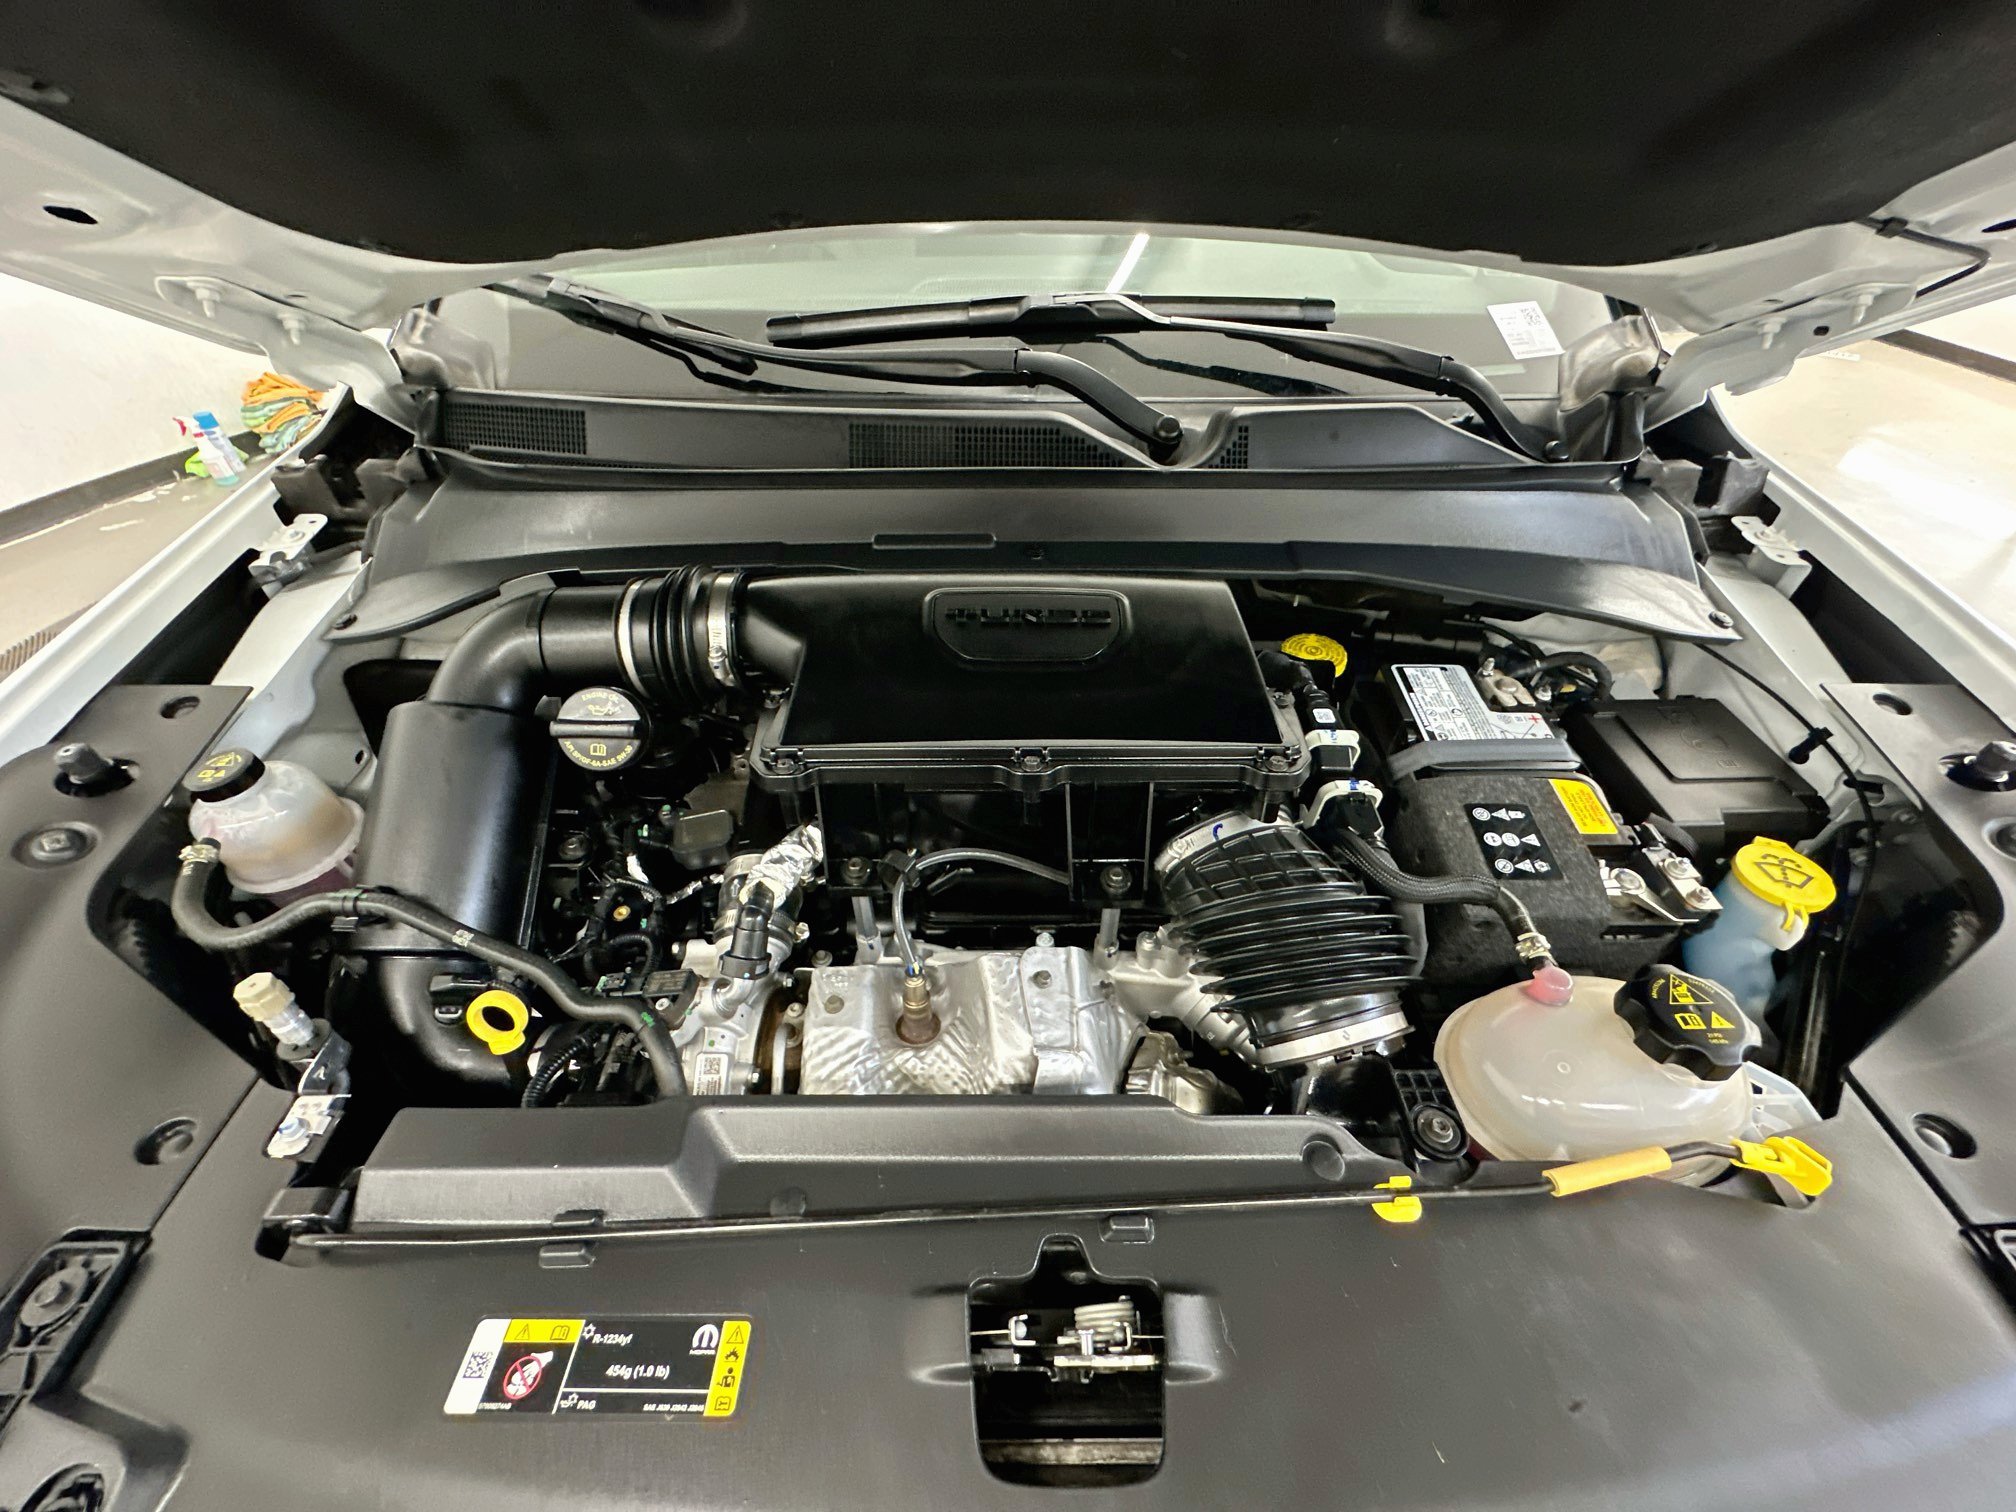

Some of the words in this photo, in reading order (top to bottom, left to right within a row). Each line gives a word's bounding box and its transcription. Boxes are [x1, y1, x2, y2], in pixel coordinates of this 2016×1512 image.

[581, 691, 608, 701] ENGINE
[592, 1333, 633, 1347] R-1234yf
[605, 1364, 632, 1380] 454g
[633, 1364, 655, 1380] (1.0
[655, 1364, 670, 1380] lb)
[577, 1400, 596, 1410] PAG
